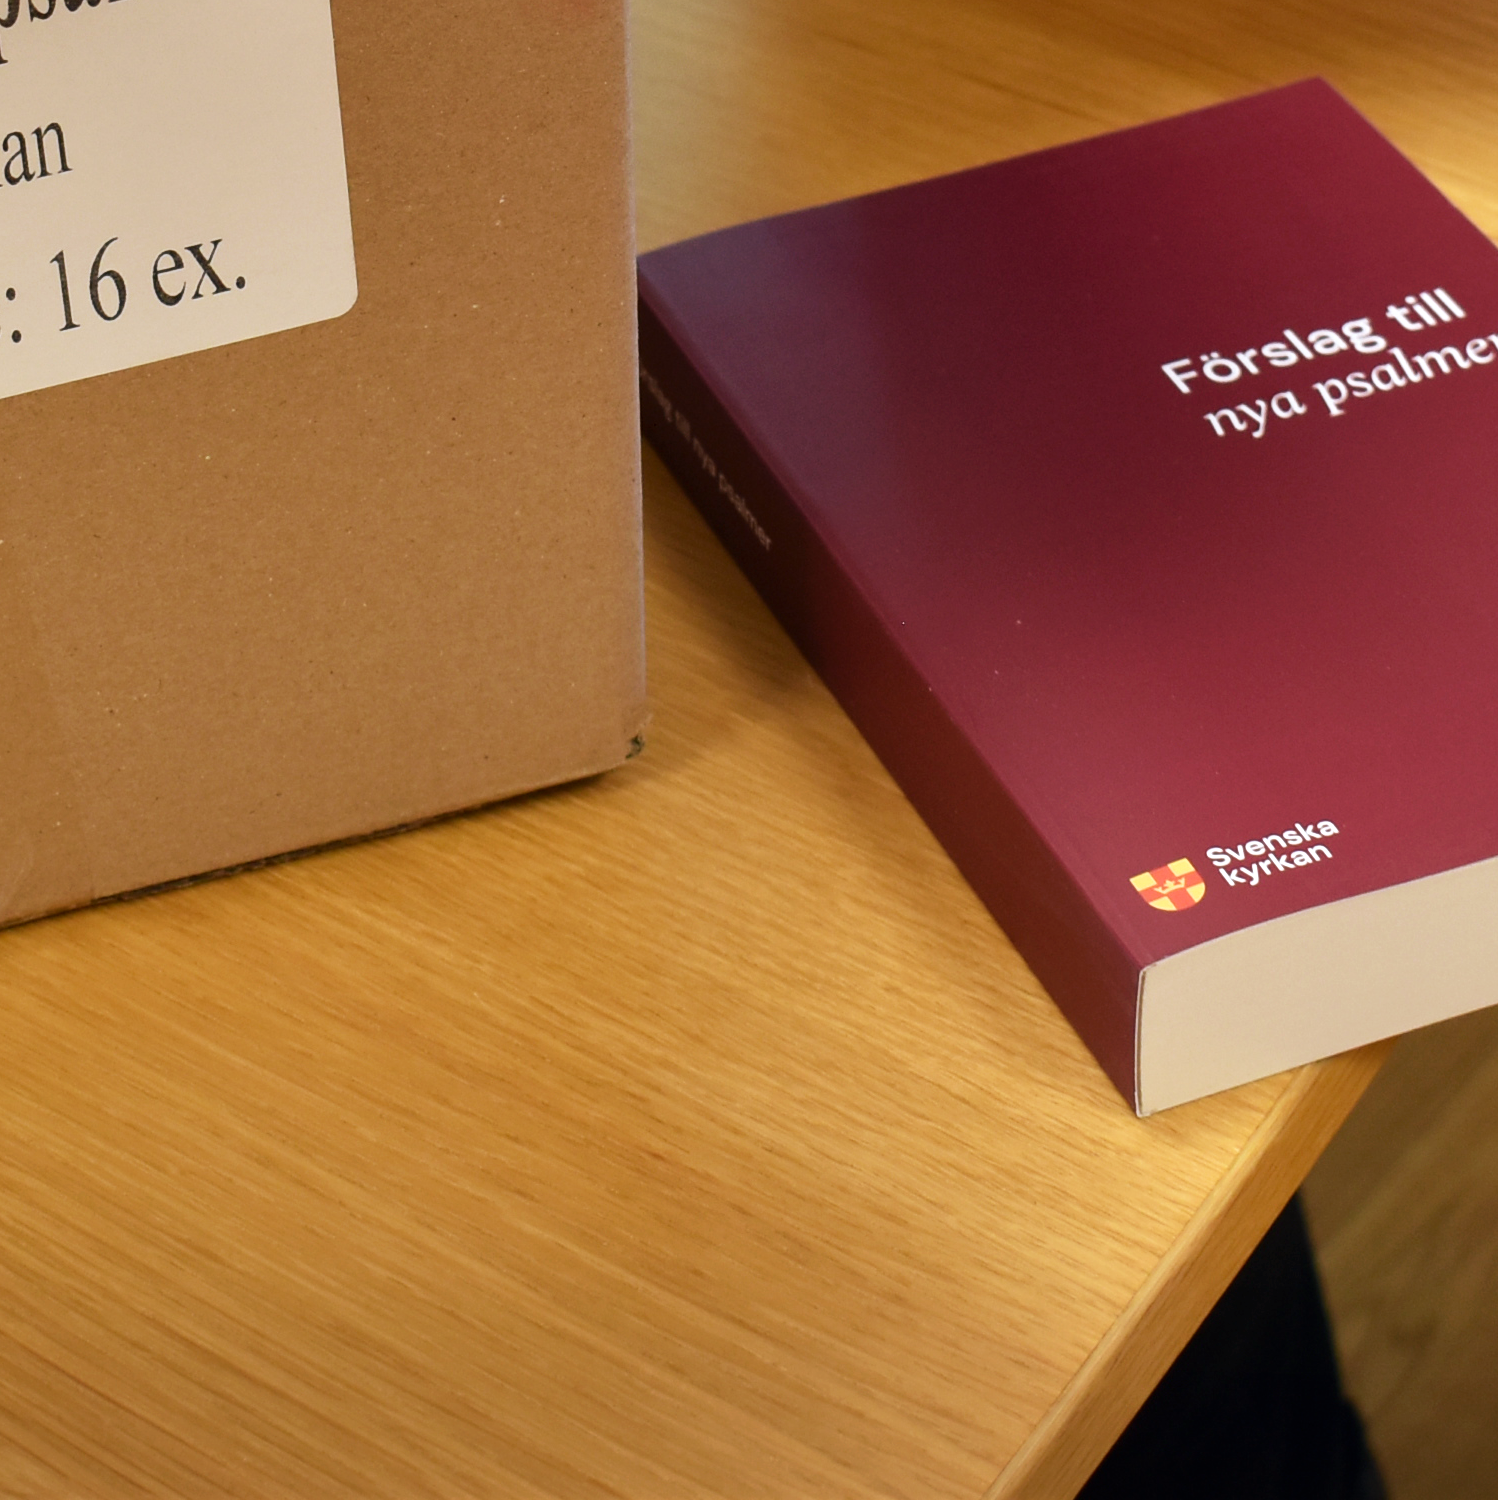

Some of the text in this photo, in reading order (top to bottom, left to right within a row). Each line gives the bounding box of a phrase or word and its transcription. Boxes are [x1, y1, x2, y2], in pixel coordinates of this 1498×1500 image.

[49, 236, 127, 333] 16
[151, 238, 247, 308] ex.
[1161, 287, 1466, 394] Förslag till
[1203, 390, 1308, 439] nya
[1205, 819, 1340, 887] Svenska kyrkan
